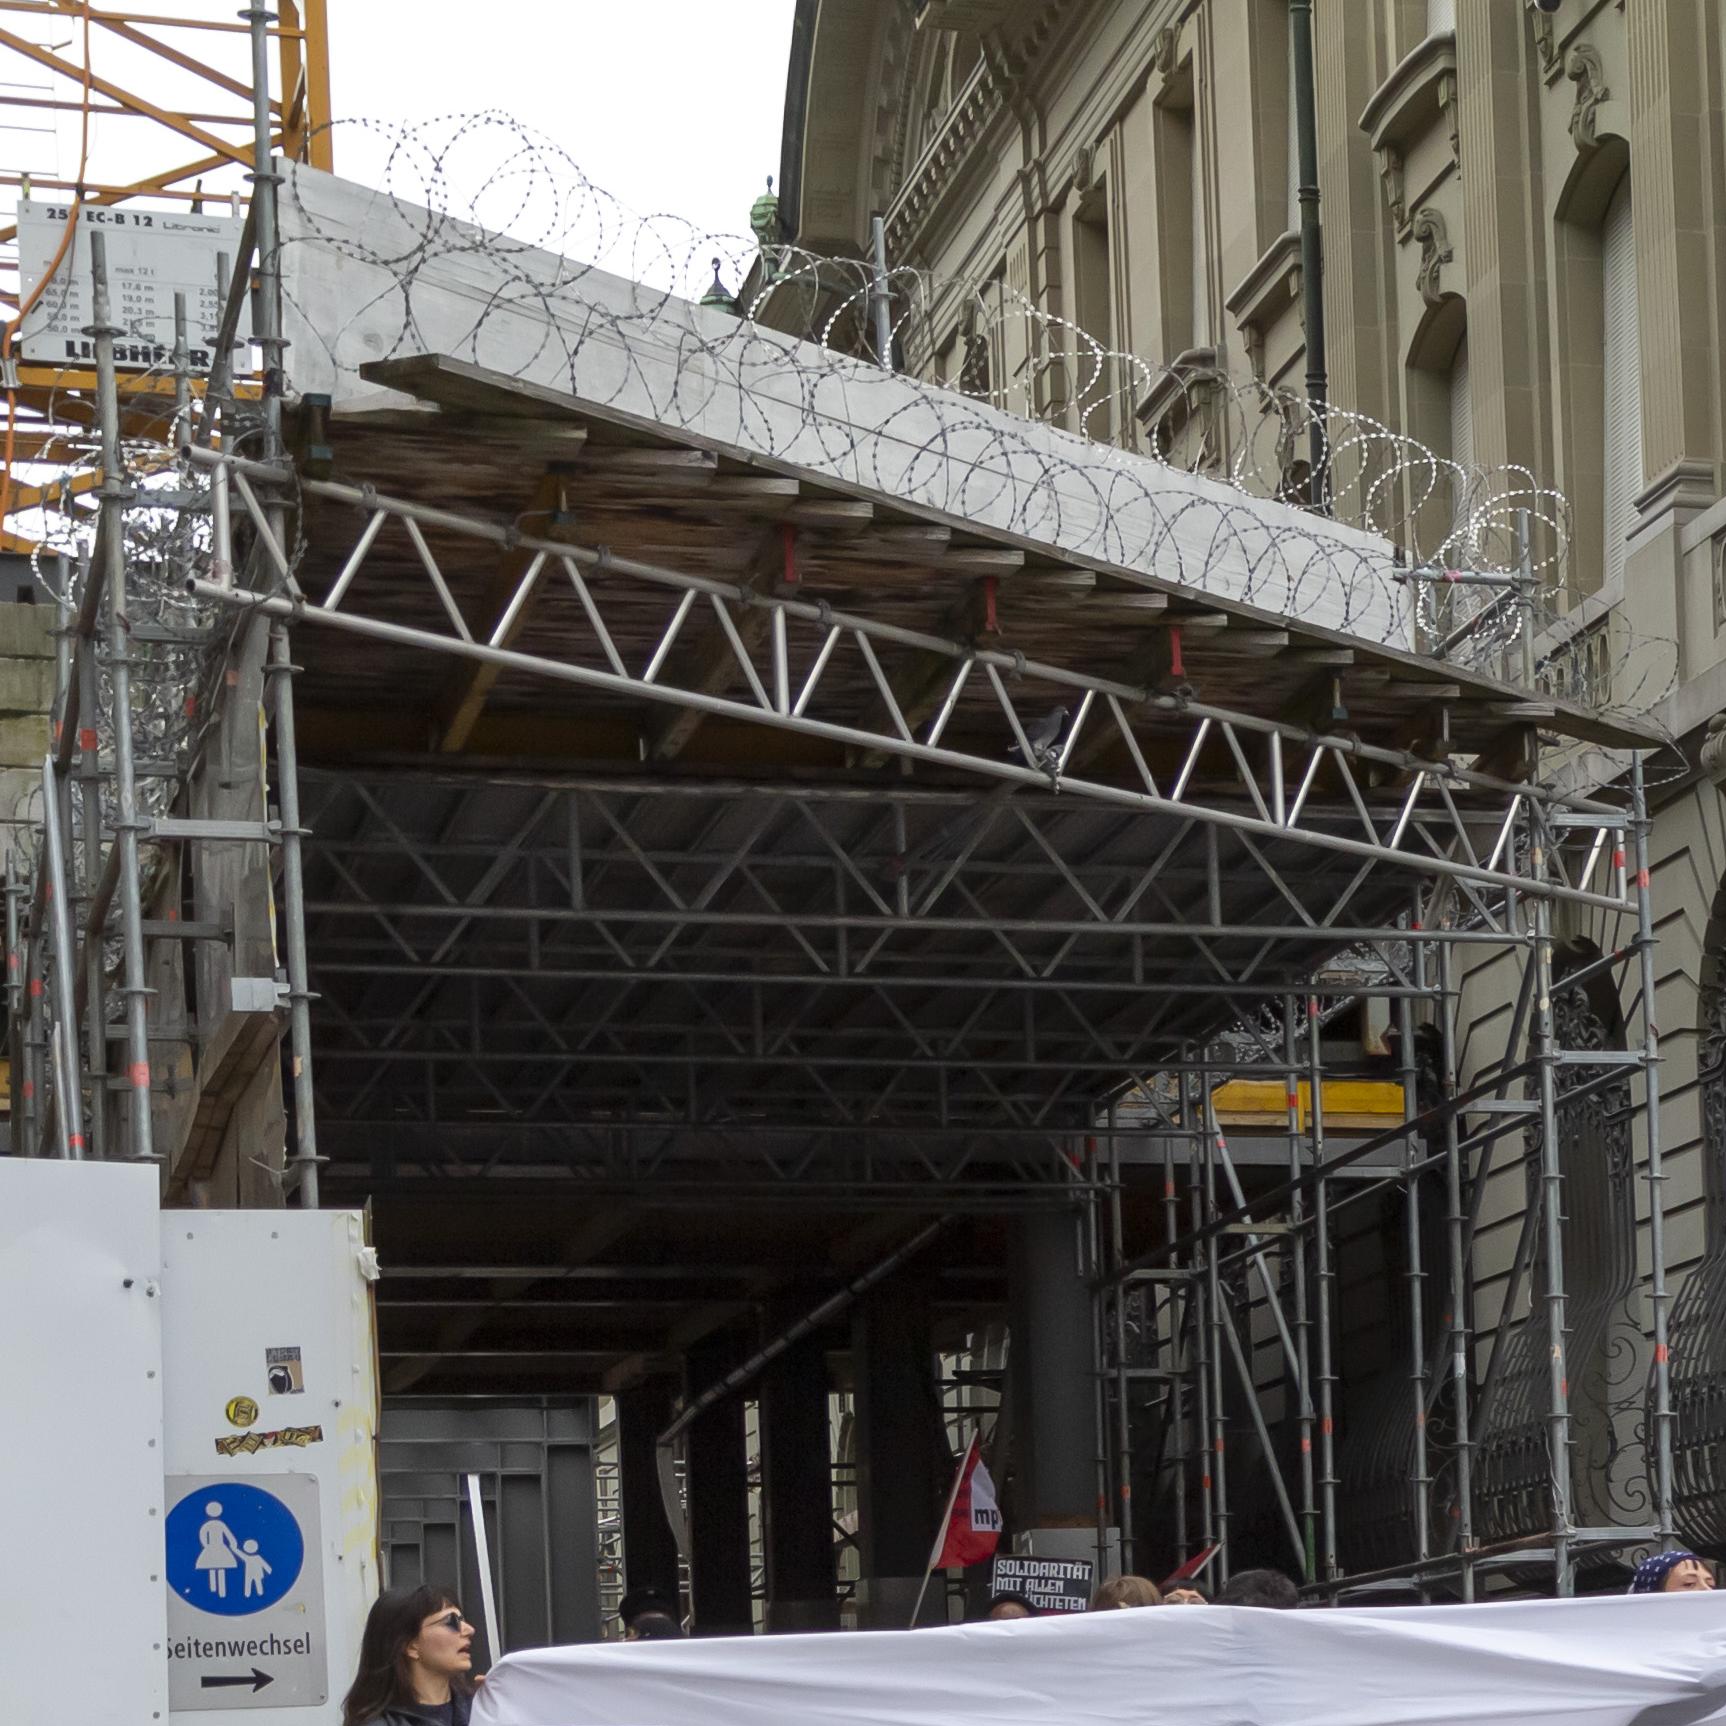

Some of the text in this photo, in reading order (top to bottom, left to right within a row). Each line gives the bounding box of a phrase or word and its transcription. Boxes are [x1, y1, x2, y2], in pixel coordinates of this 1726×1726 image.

[86, 211, 126, 225] EC-B
[133, 214, 153, 227] 12
[65, 340, 210, 367] LIBHER
[997, 1559, 1092, 1580] SOLIDARITÄT
[996, 1577, 1064, 1593] MIT ALLEN
